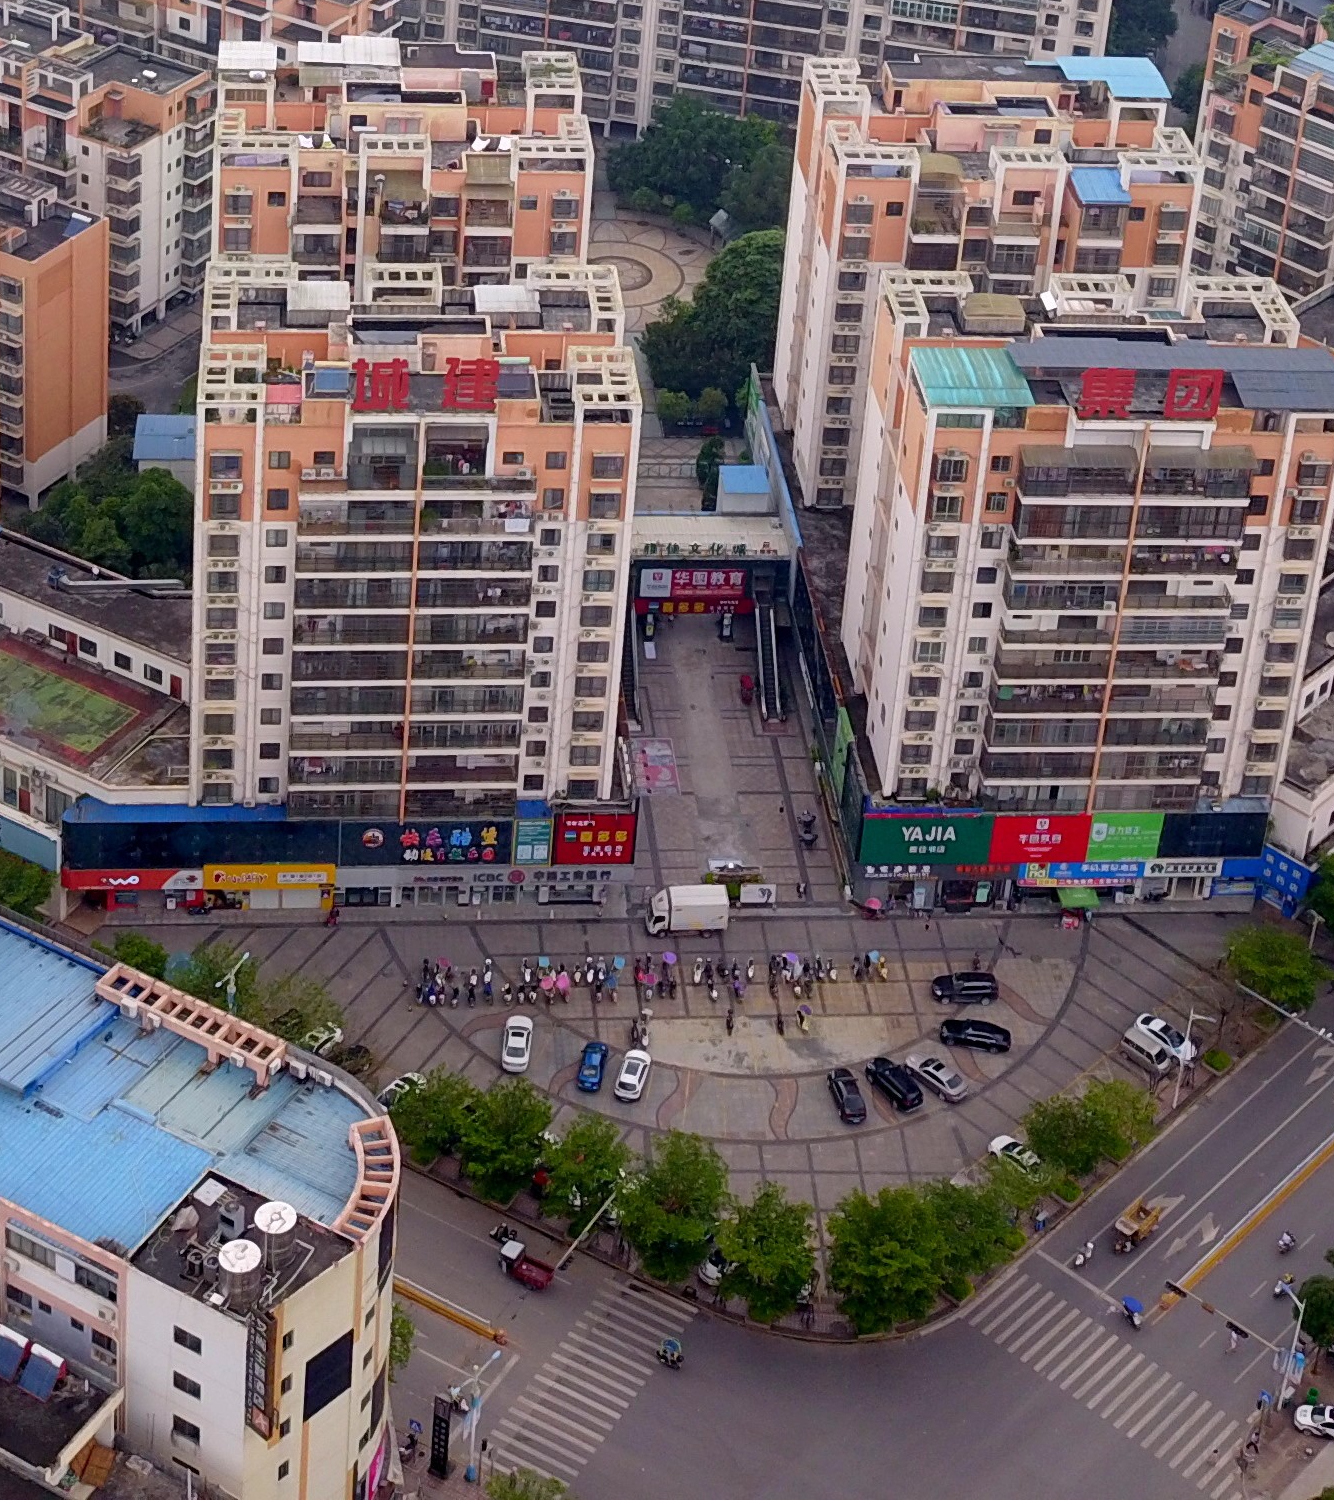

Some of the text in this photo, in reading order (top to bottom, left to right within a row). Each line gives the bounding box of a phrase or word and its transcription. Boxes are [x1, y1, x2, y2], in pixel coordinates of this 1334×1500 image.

[351, 357, 500, 411] 城建
[1079, 367, 1224, 420] 集团
[901, 825, 957, 842] YAJIA
[473, 873, 504, 883] ICBC
[533, 870, 612, 883] 中国工商银行
